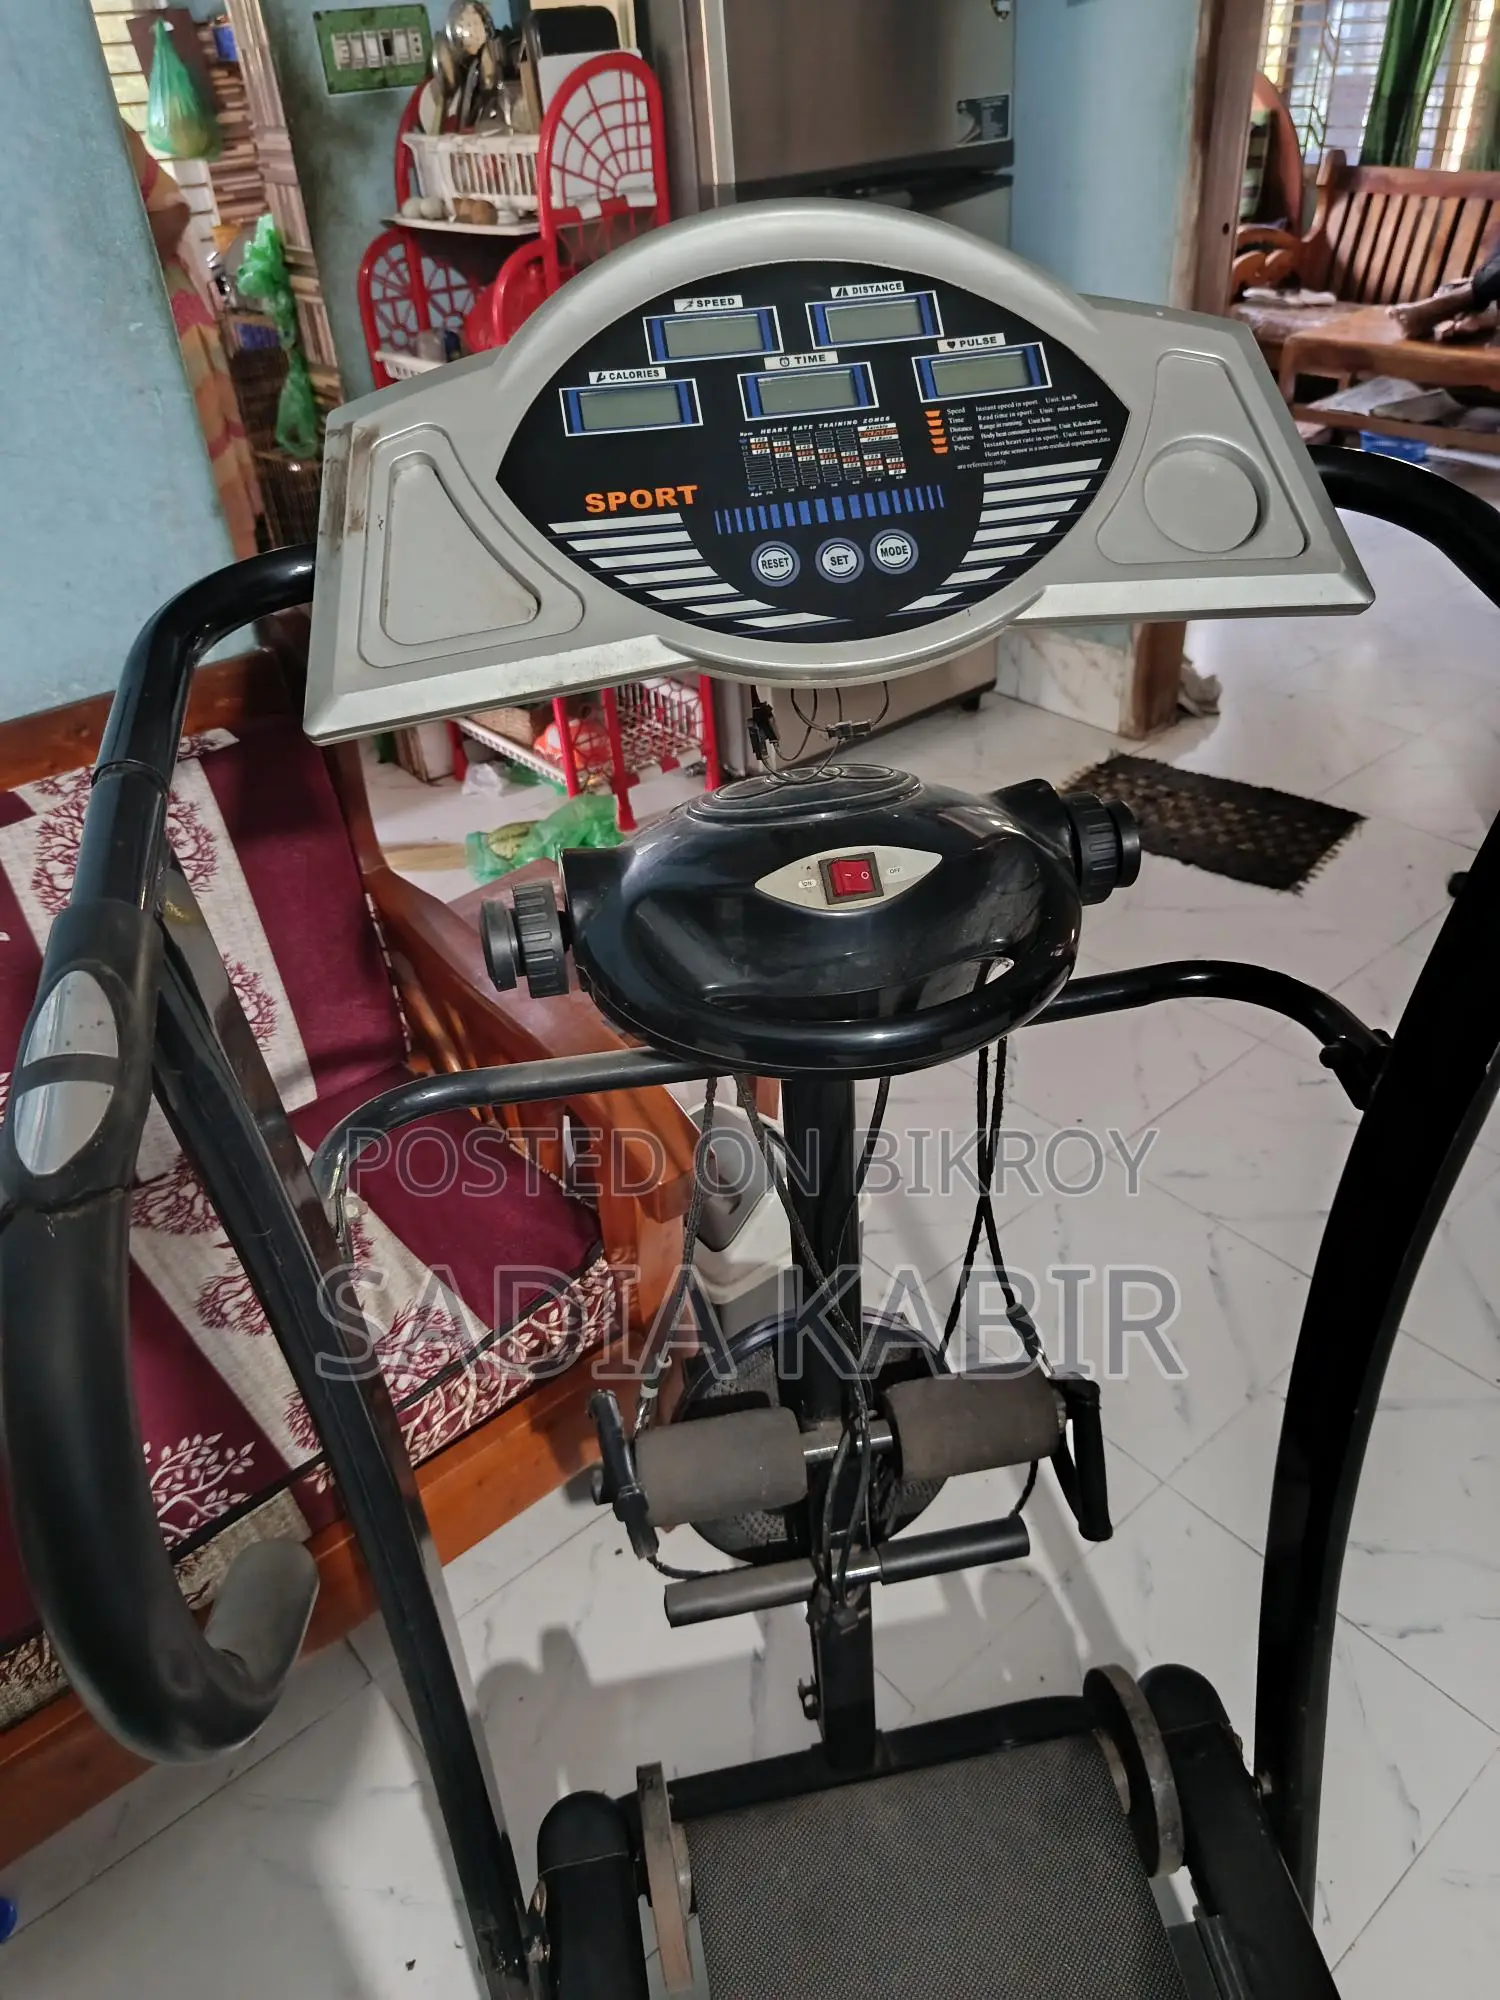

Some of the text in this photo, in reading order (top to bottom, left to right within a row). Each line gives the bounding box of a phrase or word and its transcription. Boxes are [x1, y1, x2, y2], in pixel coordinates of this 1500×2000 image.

[852, 282, 903, 295] DISTANCE
[696, 298, 735, 308] SPEED
[959, 336, 997, 348] PULSE
[794, 354, 826, 364] TIME
[609, 369, 660, 380] CALORIES
[947, 406, 965, 415] Speed
[976, 404, 996, 412] Instant
[998, 402, 1014, 410] speed
[1077, 401, 1098, 409] Second
[819, 419, 857, 428] TRAINING
[863, 416, 890, 424] ZONES
[585, 484, 698, 513] SPORT
[880, 543, 909, 557] MODE
[761, 557, 790, 569] RESET
[830, 554, 849, 567] SET
